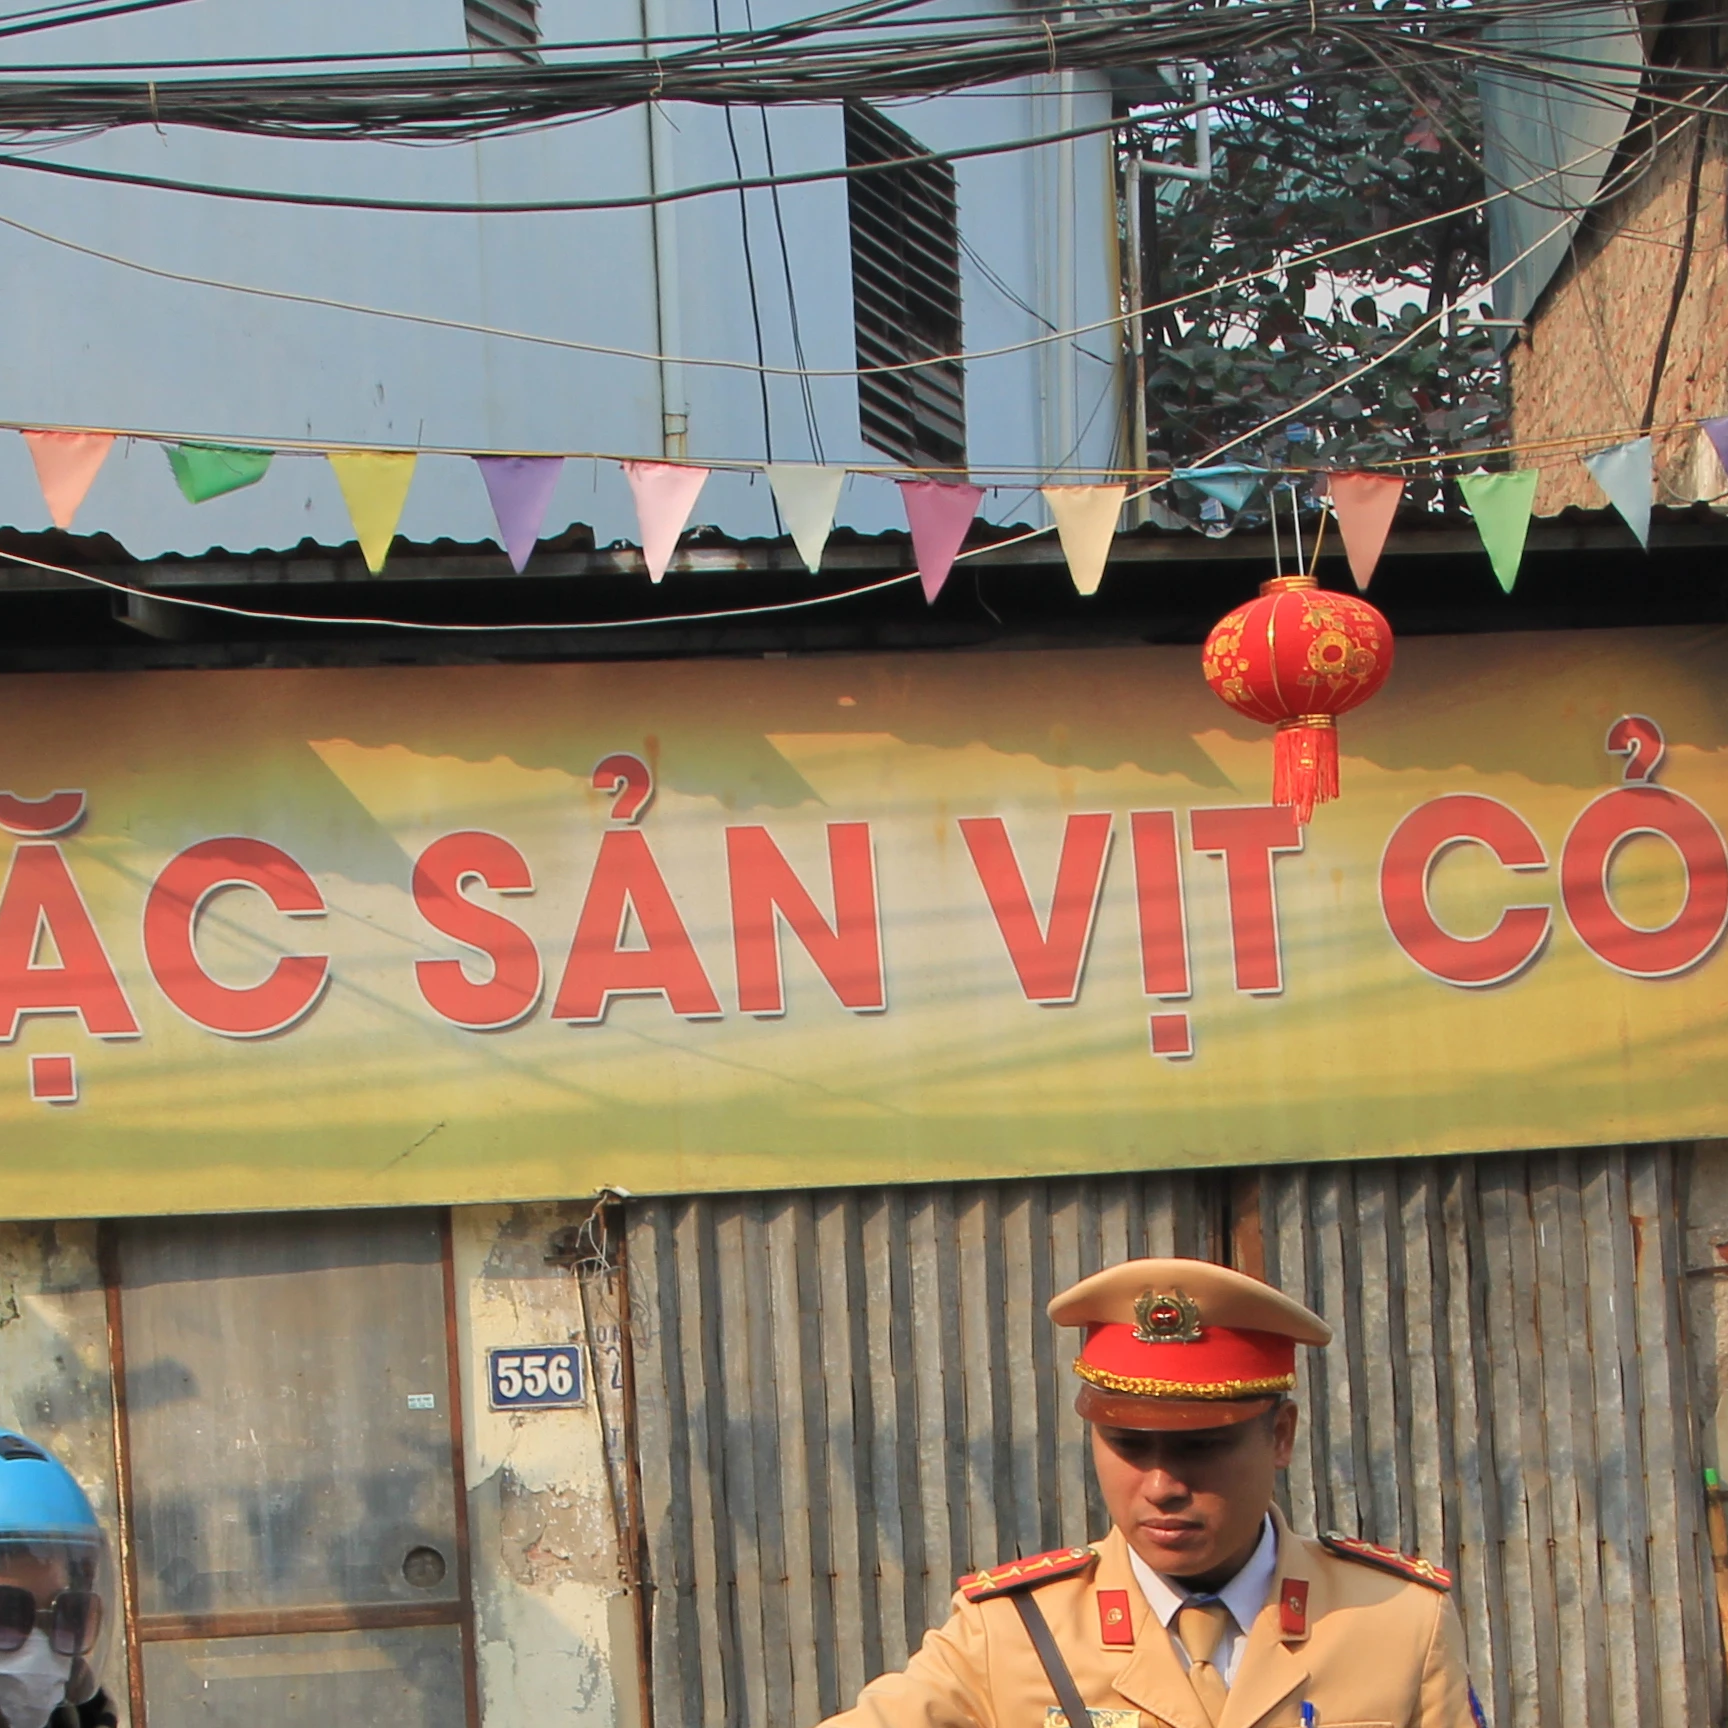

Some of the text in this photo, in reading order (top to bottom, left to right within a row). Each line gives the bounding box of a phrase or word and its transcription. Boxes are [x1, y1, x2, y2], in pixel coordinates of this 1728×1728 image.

[408, 751, 889, 1031] SẢN
[956, 804, 1306, 1061] VỊT
[497, 1353, 574, 1399] 556
